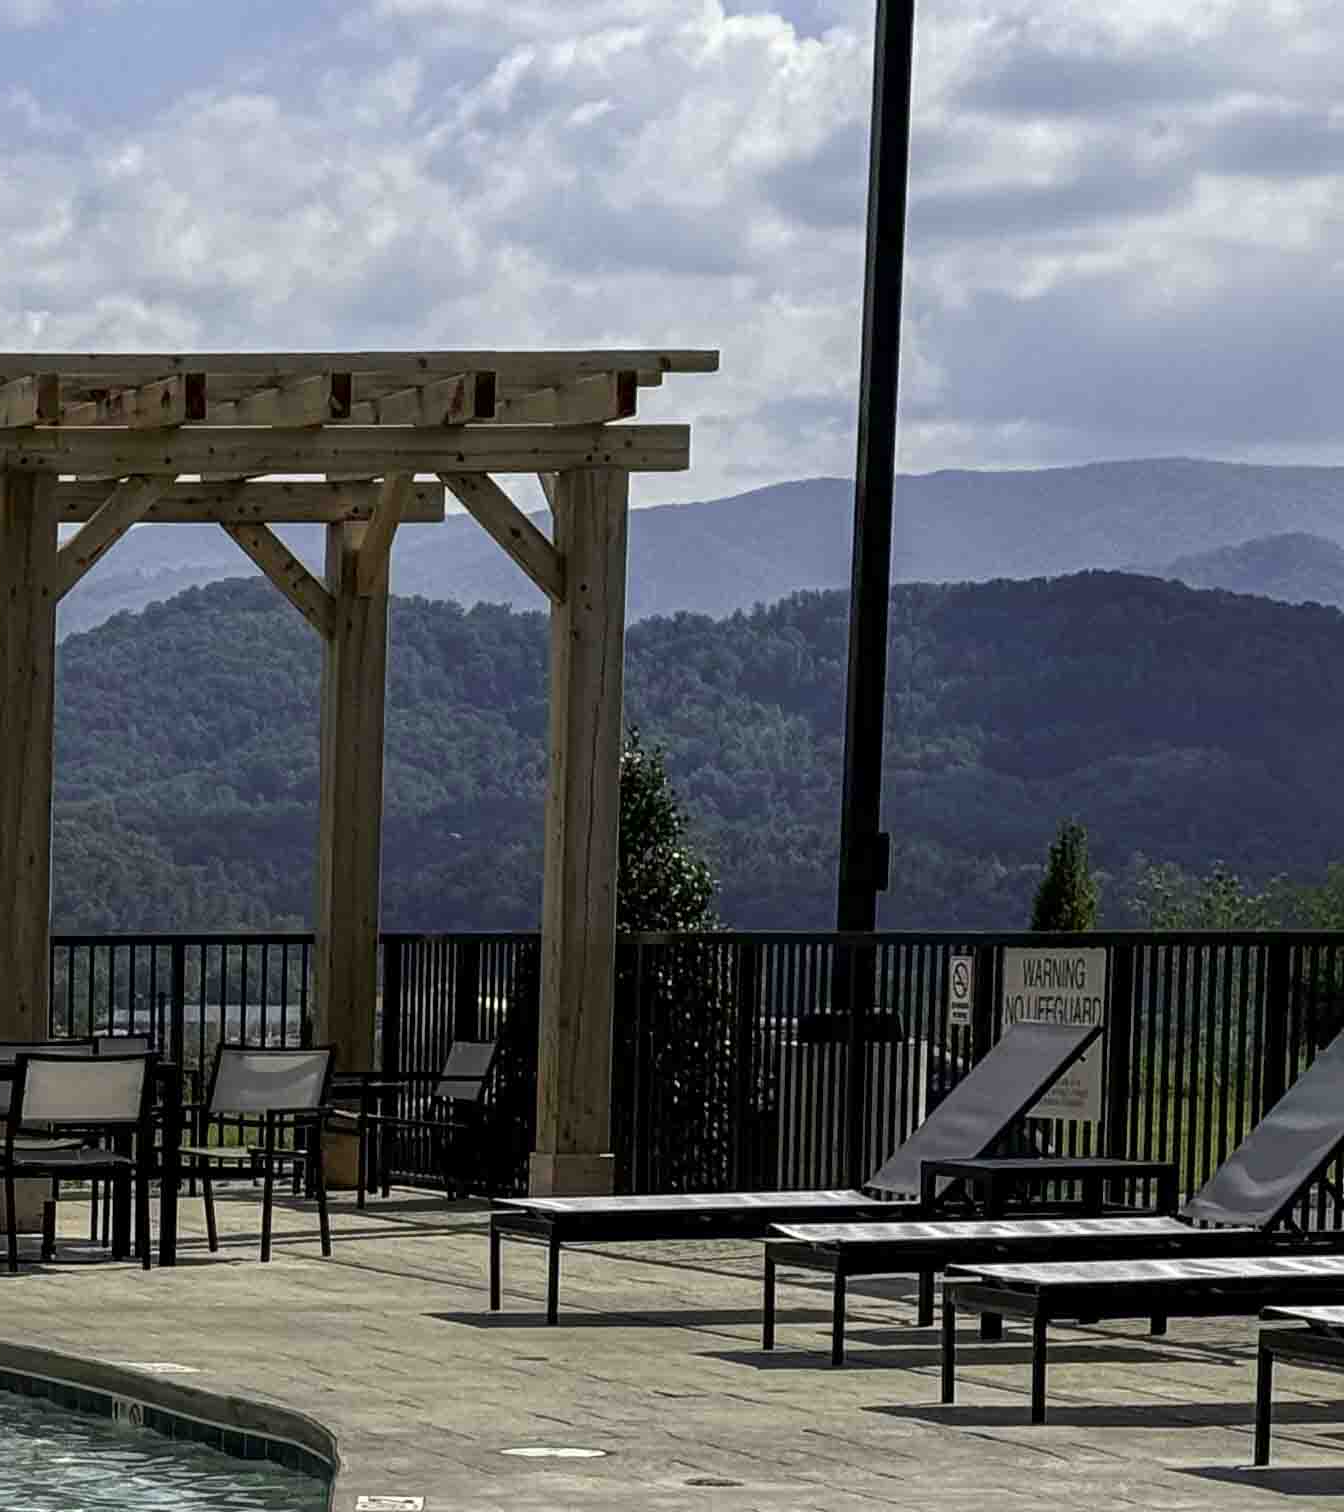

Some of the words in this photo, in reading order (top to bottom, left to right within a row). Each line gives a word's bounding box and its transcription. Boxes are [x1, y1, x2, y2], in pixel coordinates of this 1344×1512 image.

[1023, 958, 1086, 989] WARNING
[1006, 994, 1025, 1024] NO
[1026, 994, 1102, 1024] LIFEGUARD
